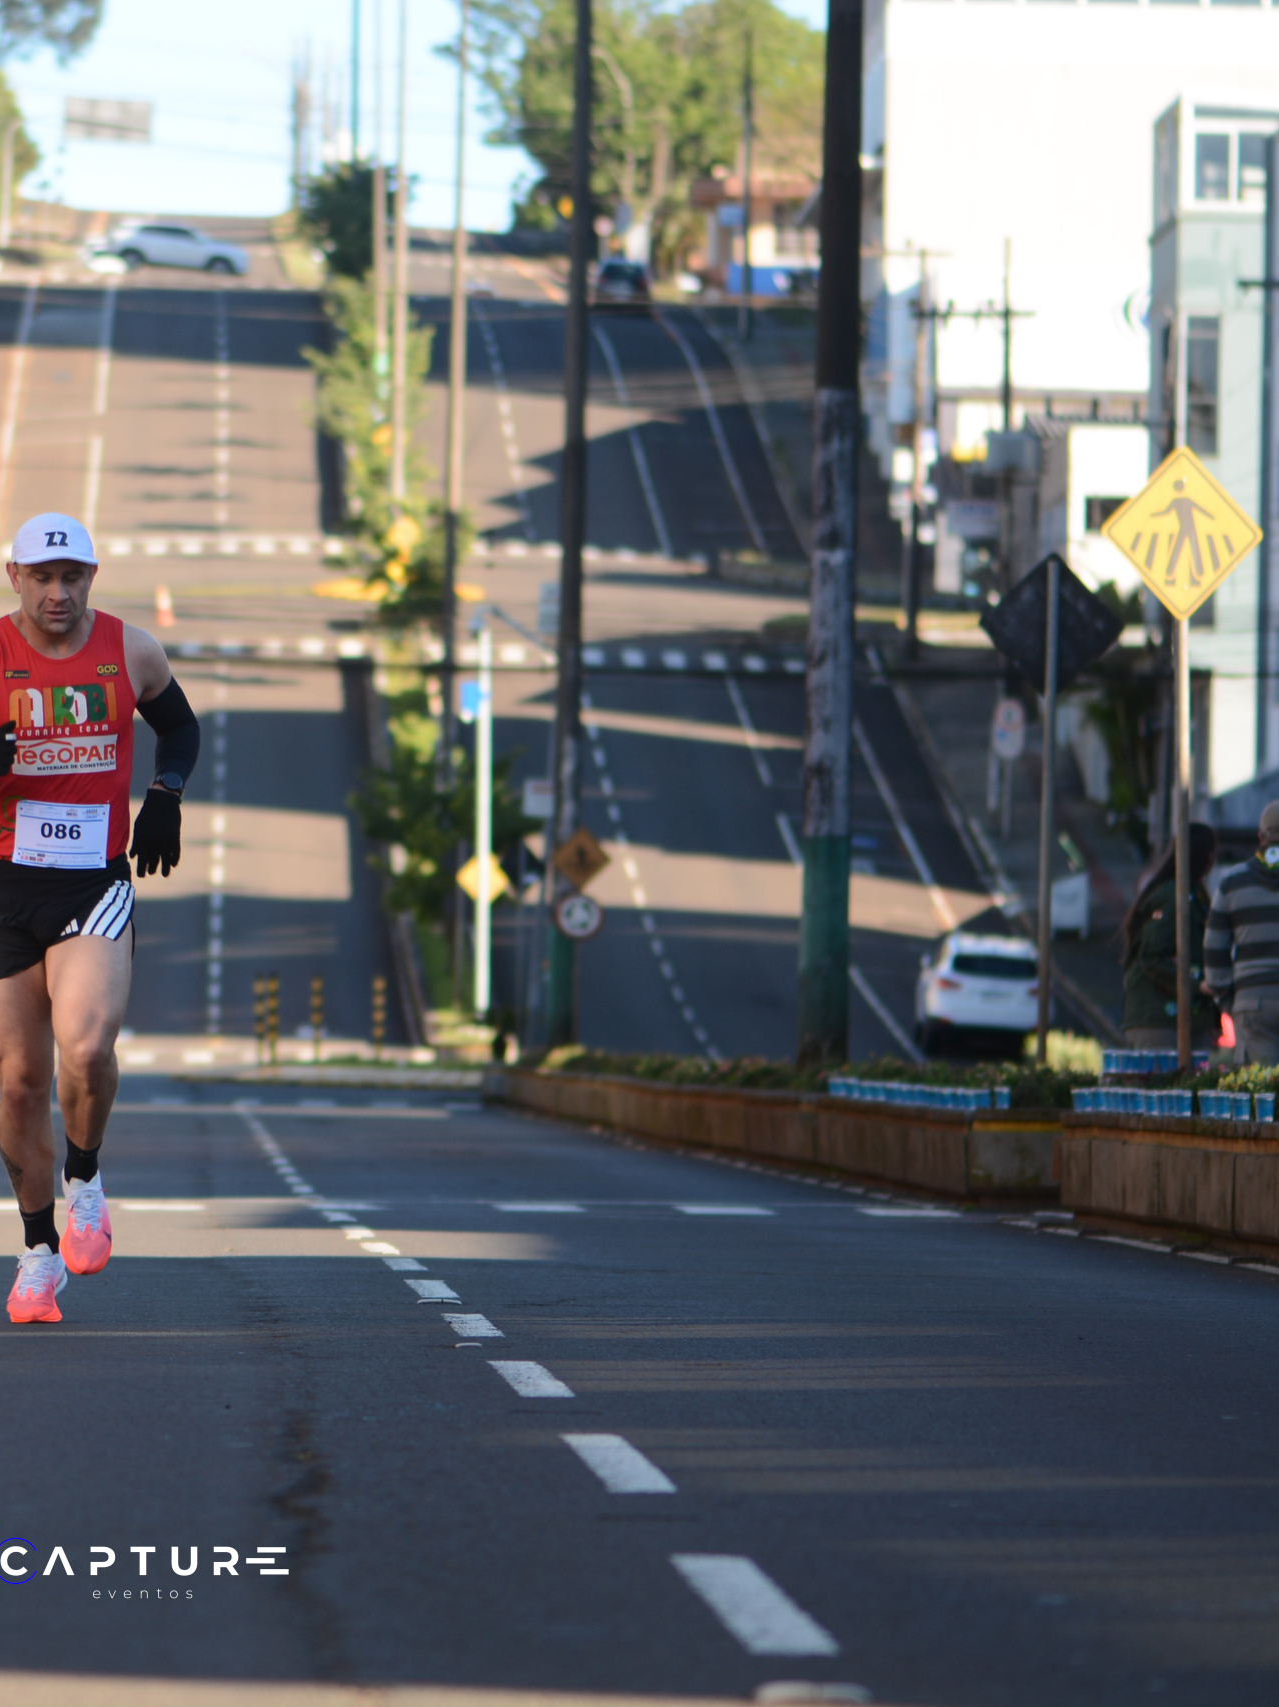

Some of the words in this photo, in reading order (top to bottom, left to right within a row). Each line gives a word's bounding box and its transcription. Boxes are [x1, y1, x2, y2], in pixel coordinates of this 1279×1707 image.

[20, 726, 70, 737] running
[79, 723, 109, 733] team
[79, 761, 115, 769] CONSTRUÇÃO
[40, 822, 81, 840] 086
